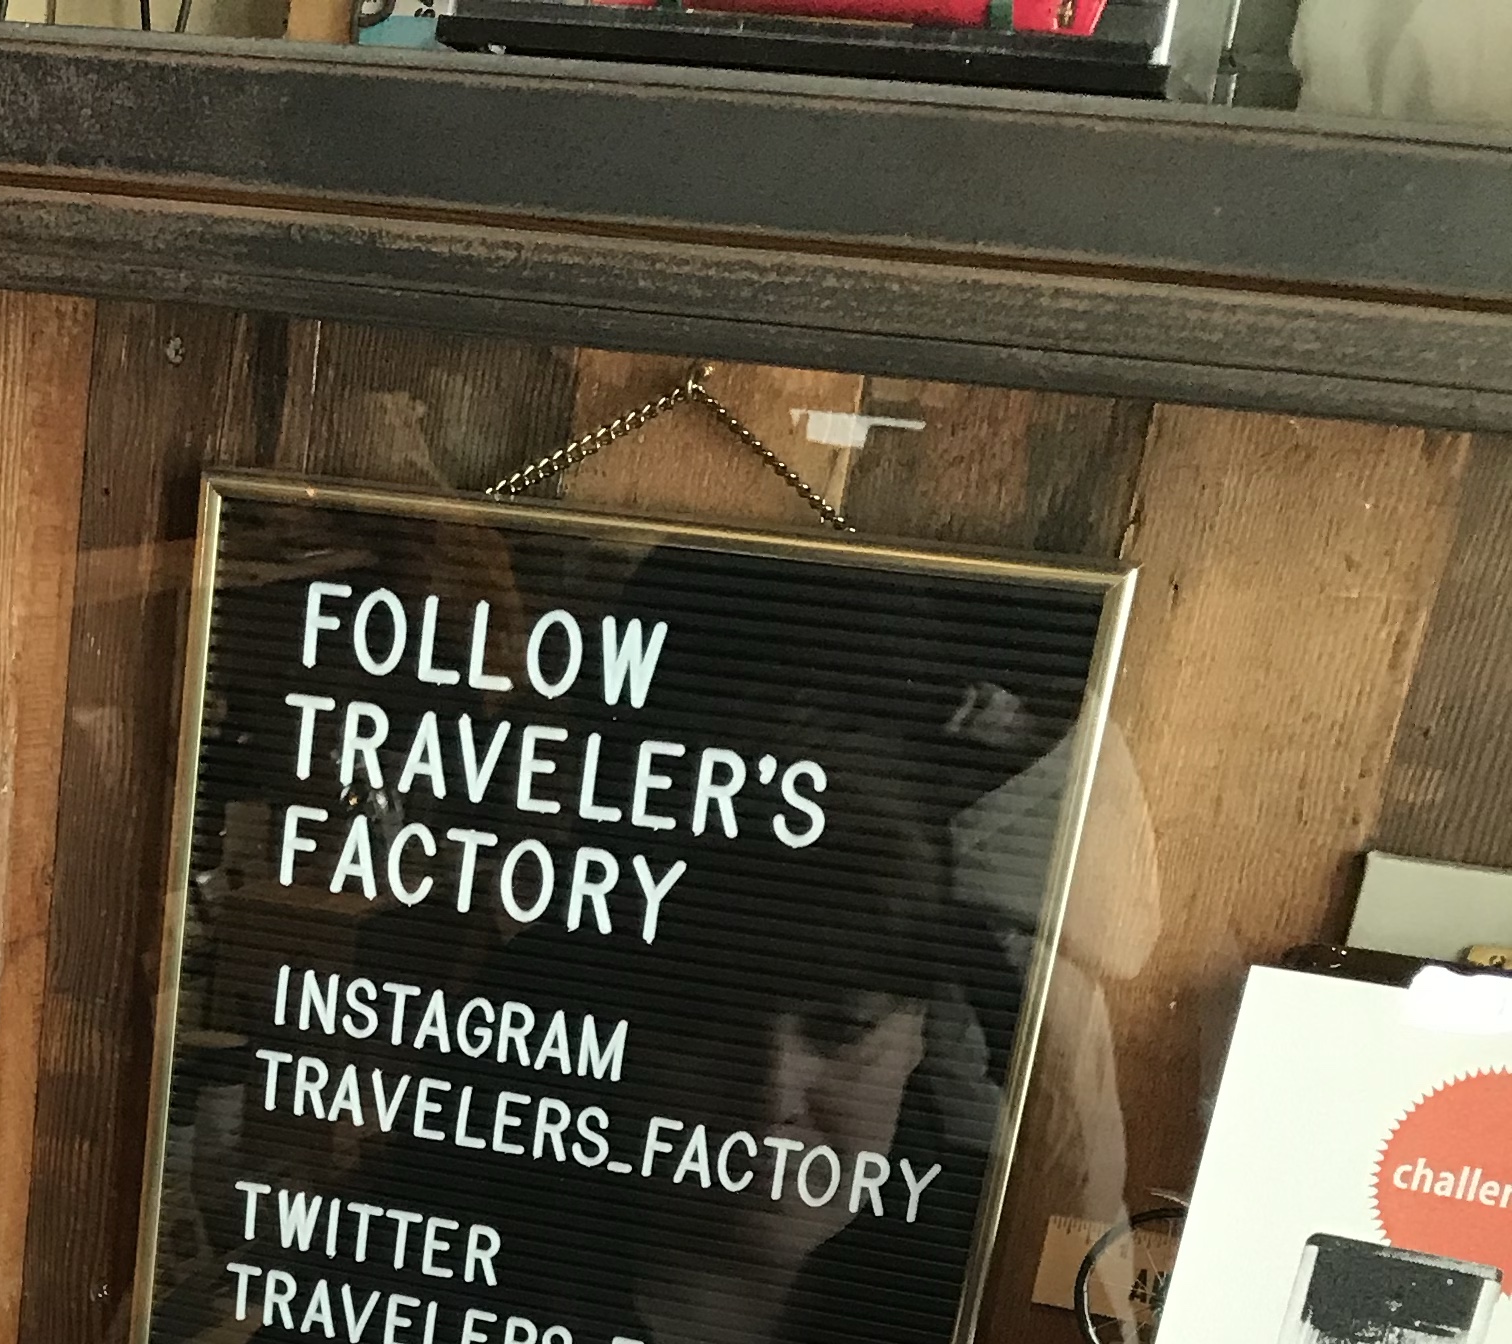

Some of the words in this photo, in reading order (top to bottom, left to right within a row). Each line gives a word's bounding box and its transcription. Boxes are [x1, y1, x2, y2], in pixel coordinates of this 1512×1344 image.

[301, 582, 668, 710] FOLLOW
[285, 694, 827, 849] TRAVELER'S
[278, 806, 687, 945] FACTORY
[273, 965, 628, 1083] INSTAGRAM
[255, 1050, 941, 1224] TRAVELERS_FACTORY
[234, 1181, 502, 1287] TWITTER
